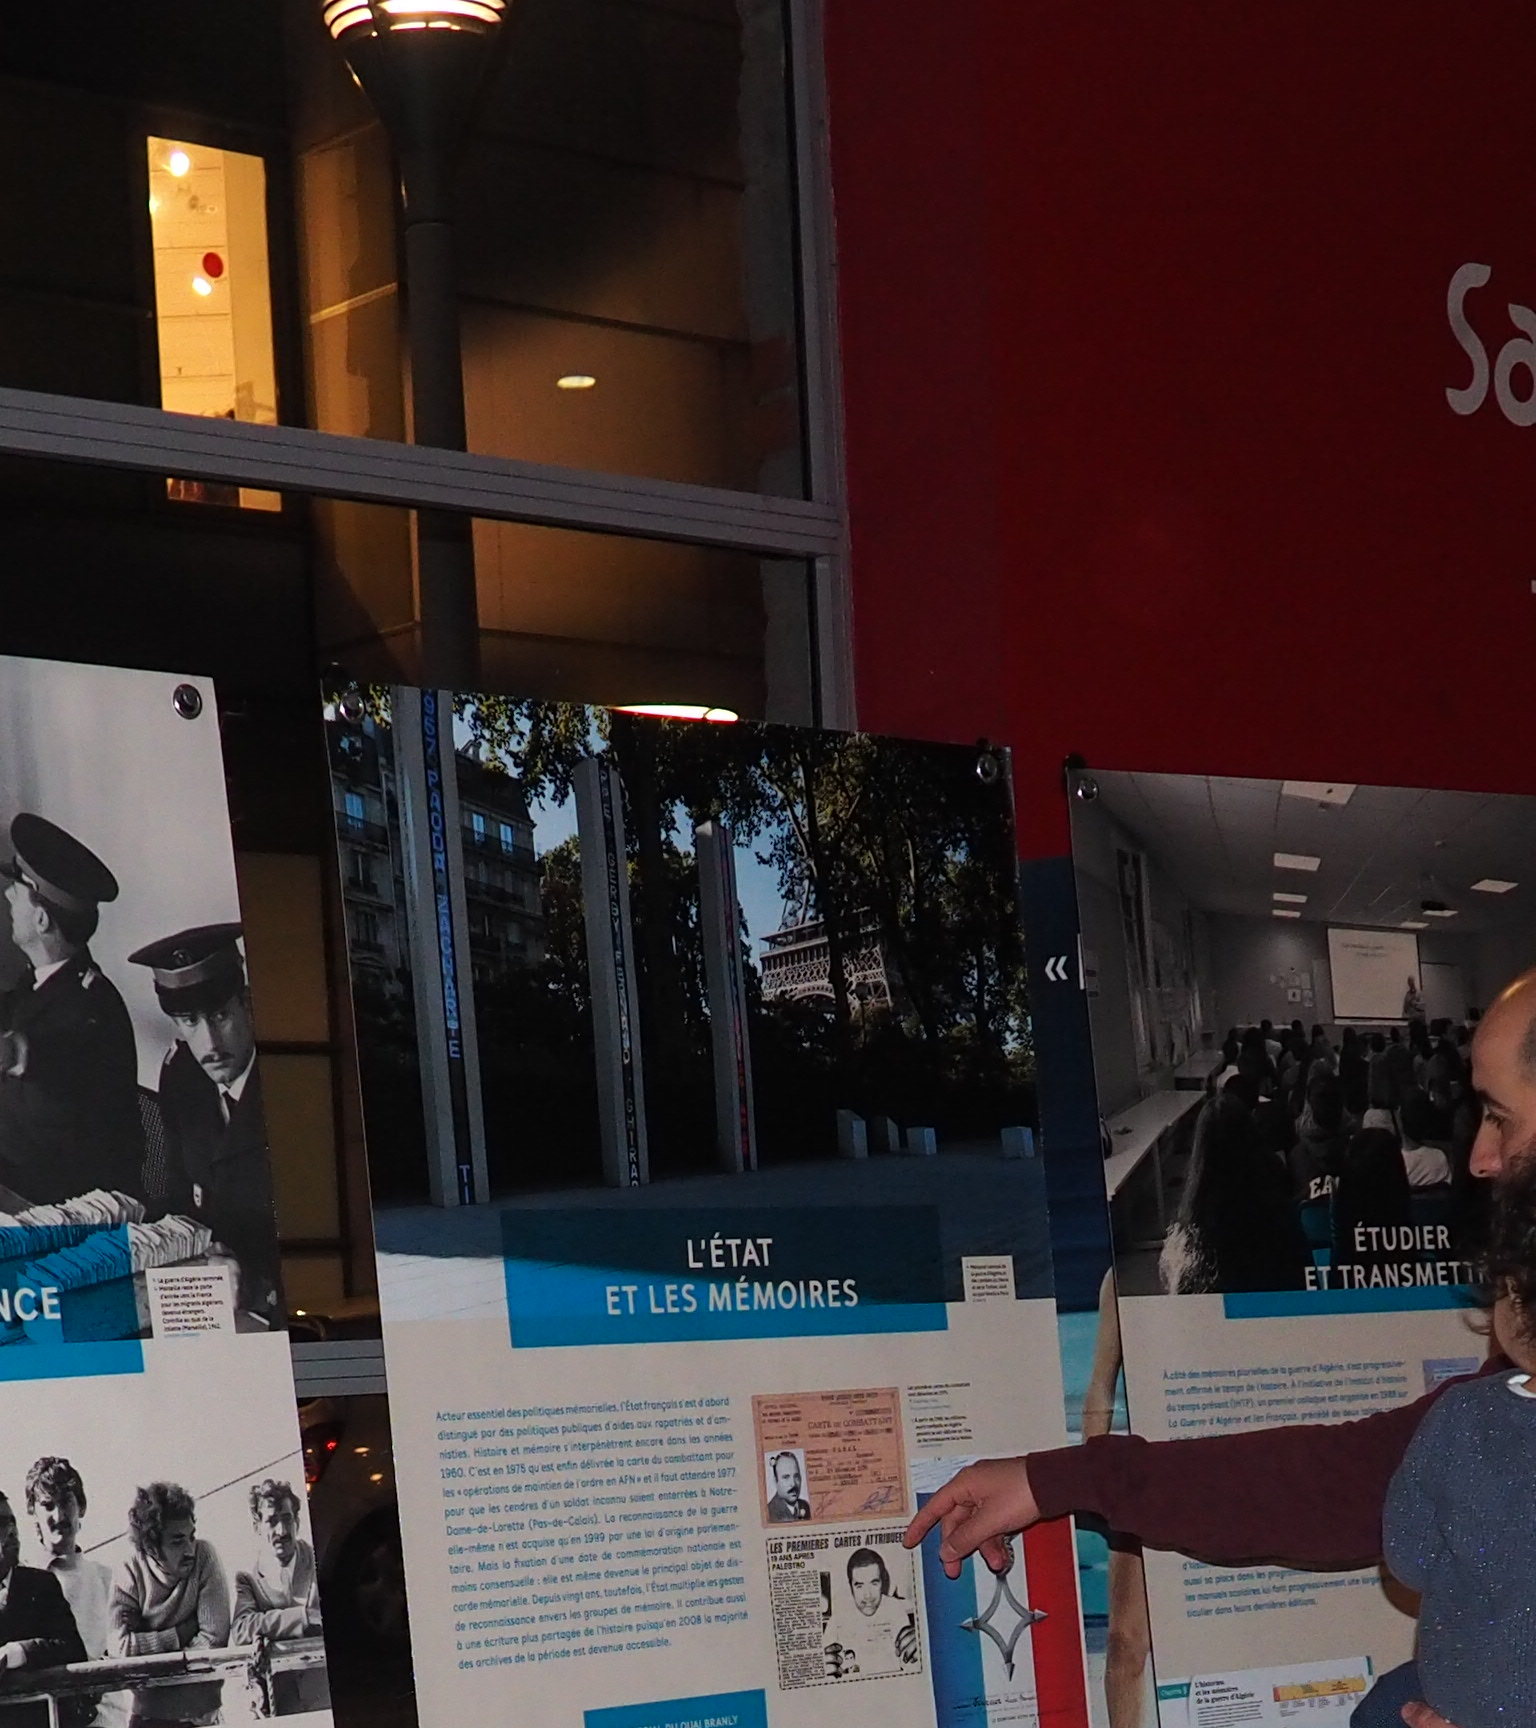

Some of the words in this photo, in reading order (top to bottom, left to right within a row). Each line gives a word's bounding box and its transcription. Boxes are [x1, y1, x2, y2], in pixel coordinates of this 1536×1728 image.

[686, 1231, 773, 1269] L'ÉTAT
[1353, 1220, 1452, 1252] ÉTUDIER
[1304, 1265, 1332, 1292] ET
[605, 1285, 638, 1316] ET
[648, 1283, 697, 1314] LES
[708, 1275, 859, 1312] MÉMOIRES
[770, 1542, 783, 1555] LES
[786, 1538, 830, 1553] PREMIERES
[834, 1535, 862, 1549] CARTES
[704, 1715, 739, 1728] BRANLY
